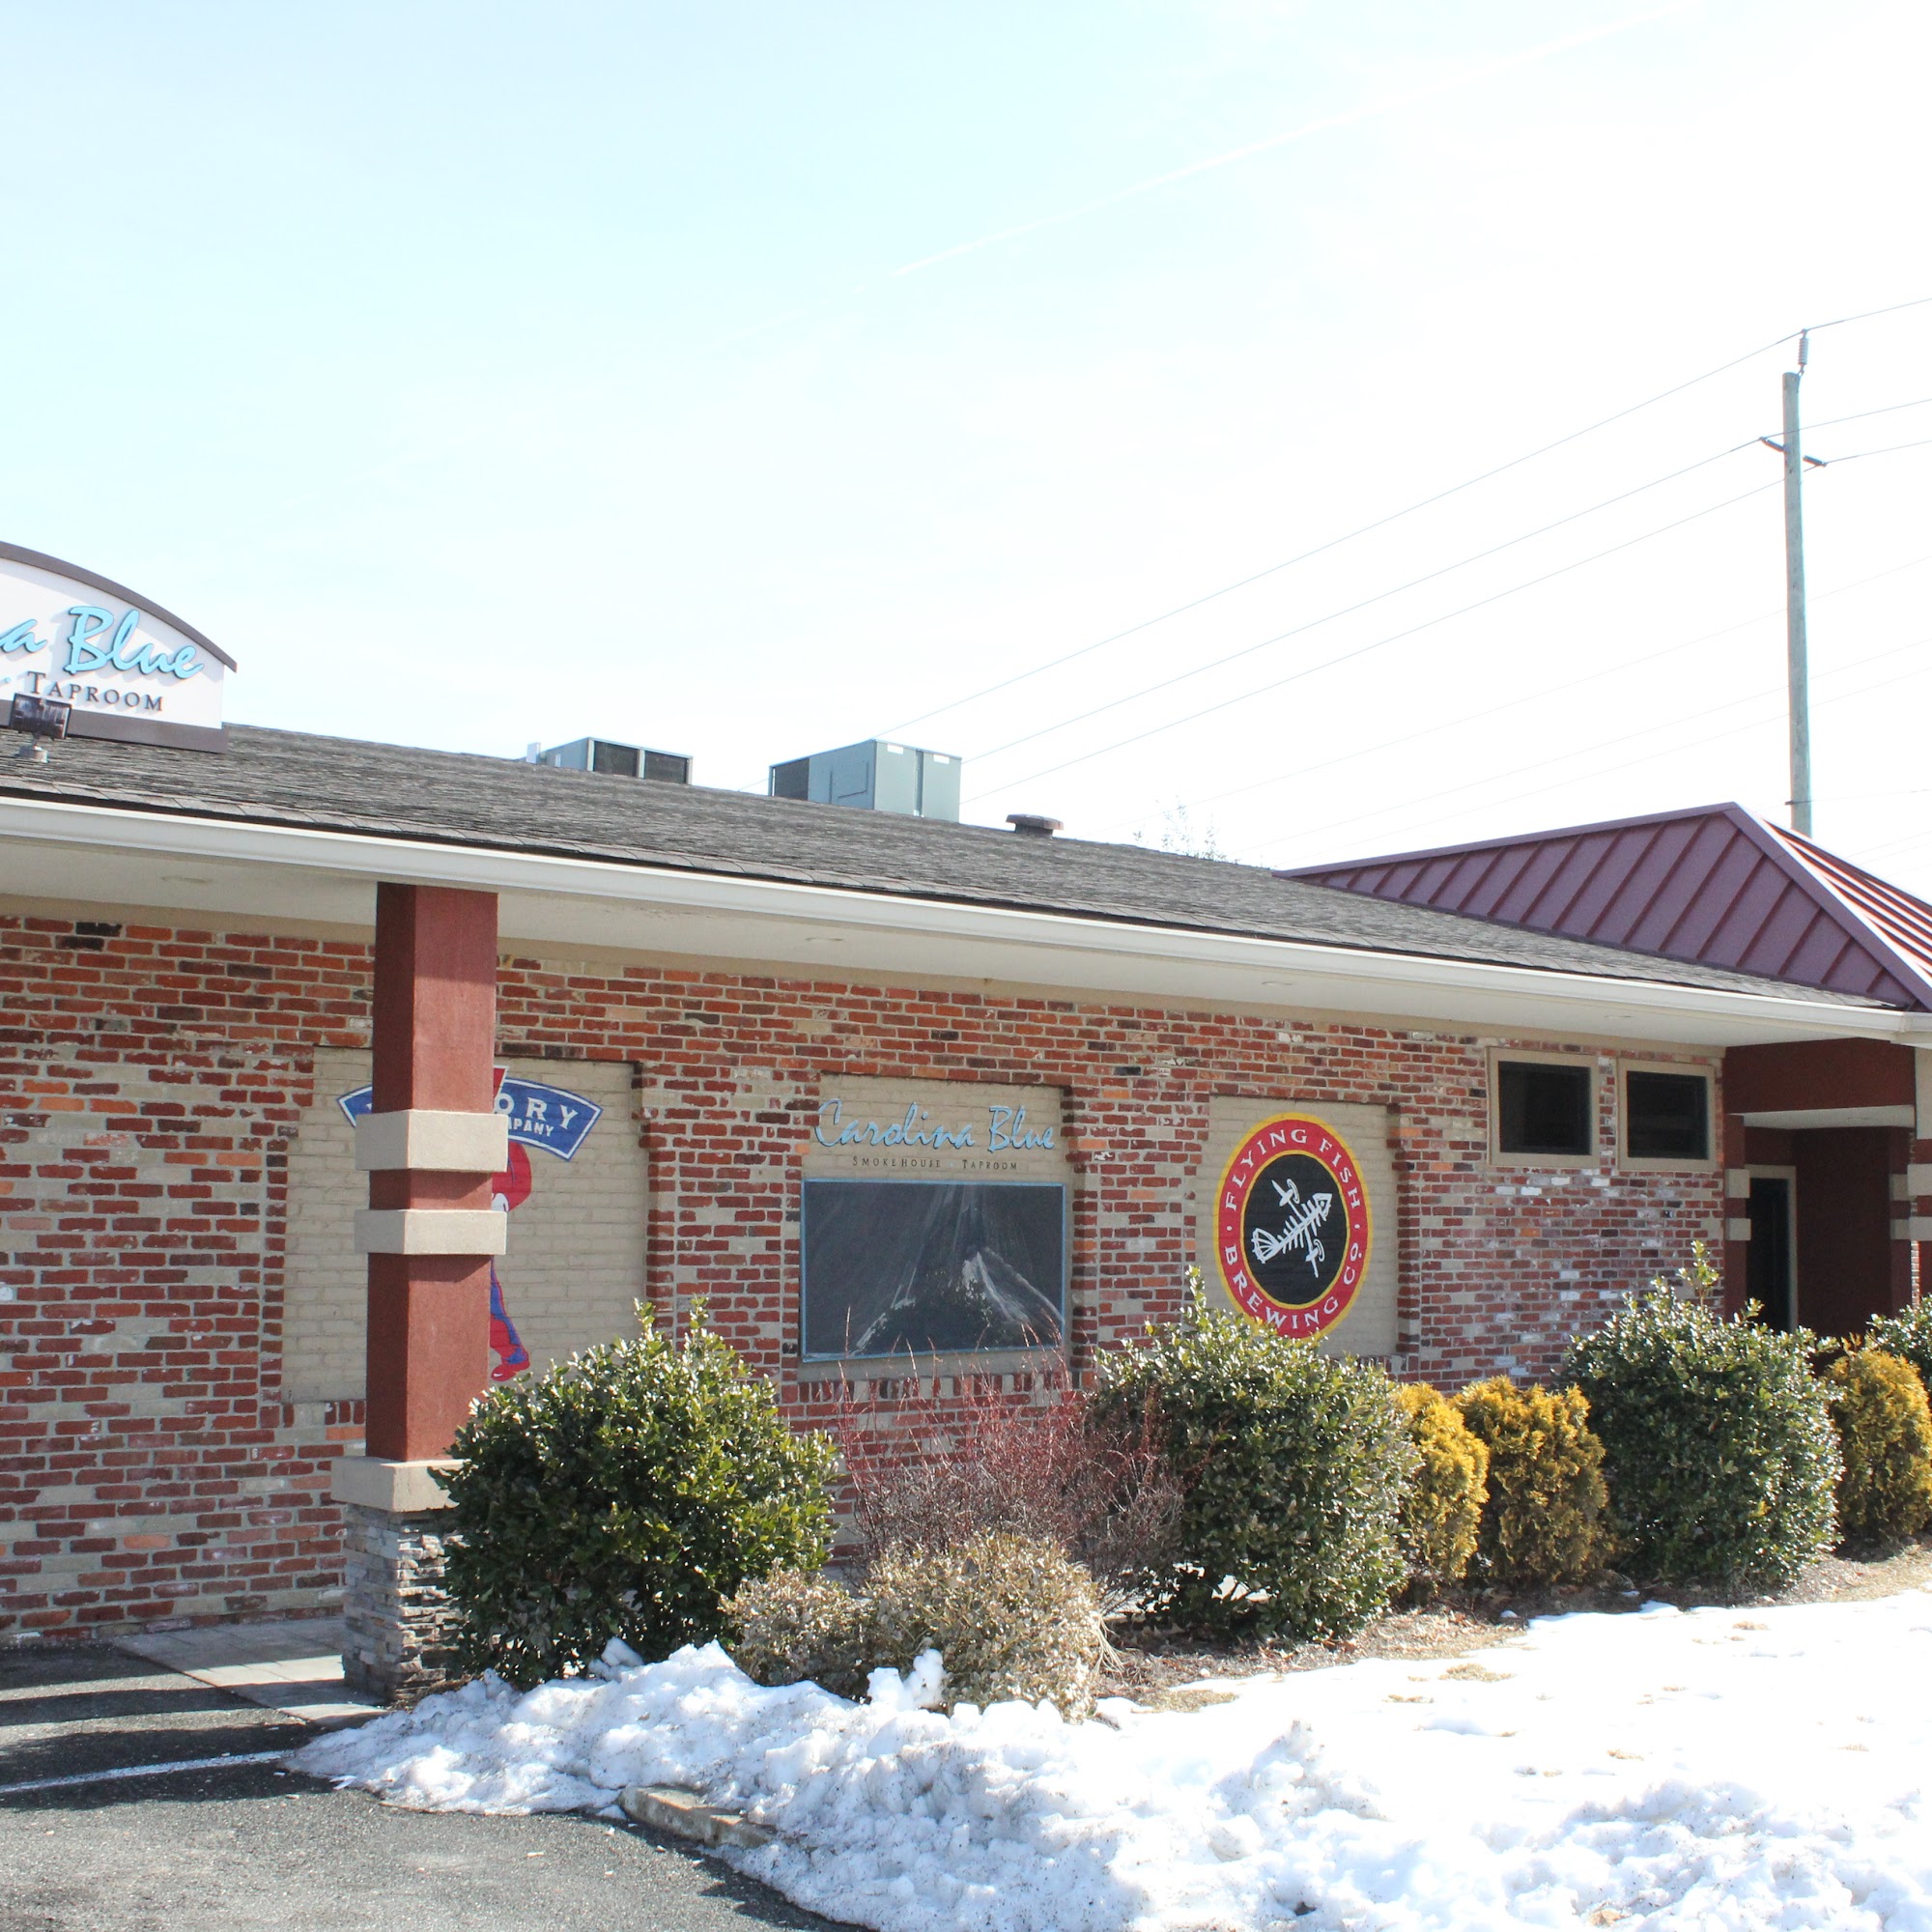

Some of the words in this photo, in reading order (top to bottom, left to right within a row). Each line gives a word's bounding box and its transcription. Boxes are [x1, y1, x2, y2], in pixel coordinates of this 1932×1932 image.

[63, 606, 204, 679] Blue
[27, 670, 164, 712] TAPROOM
[494, 1093, 579, 1130] ORY
[508, 1117, 554, 1137] PANY
[814, 1098, 976, 1150] Carolina
[987, 1105, 1056, 1153] Blue
[852, 1155, 942, 1168] SMOKEHOUSE
[962, 1159, 1018, 1171] TAPROOM
[1225, 1128, 1309, 1211] FLYING
[1318, 1138, 1361, 1209] FISH
[1224, 1244, 1340, 1330] BREWING
